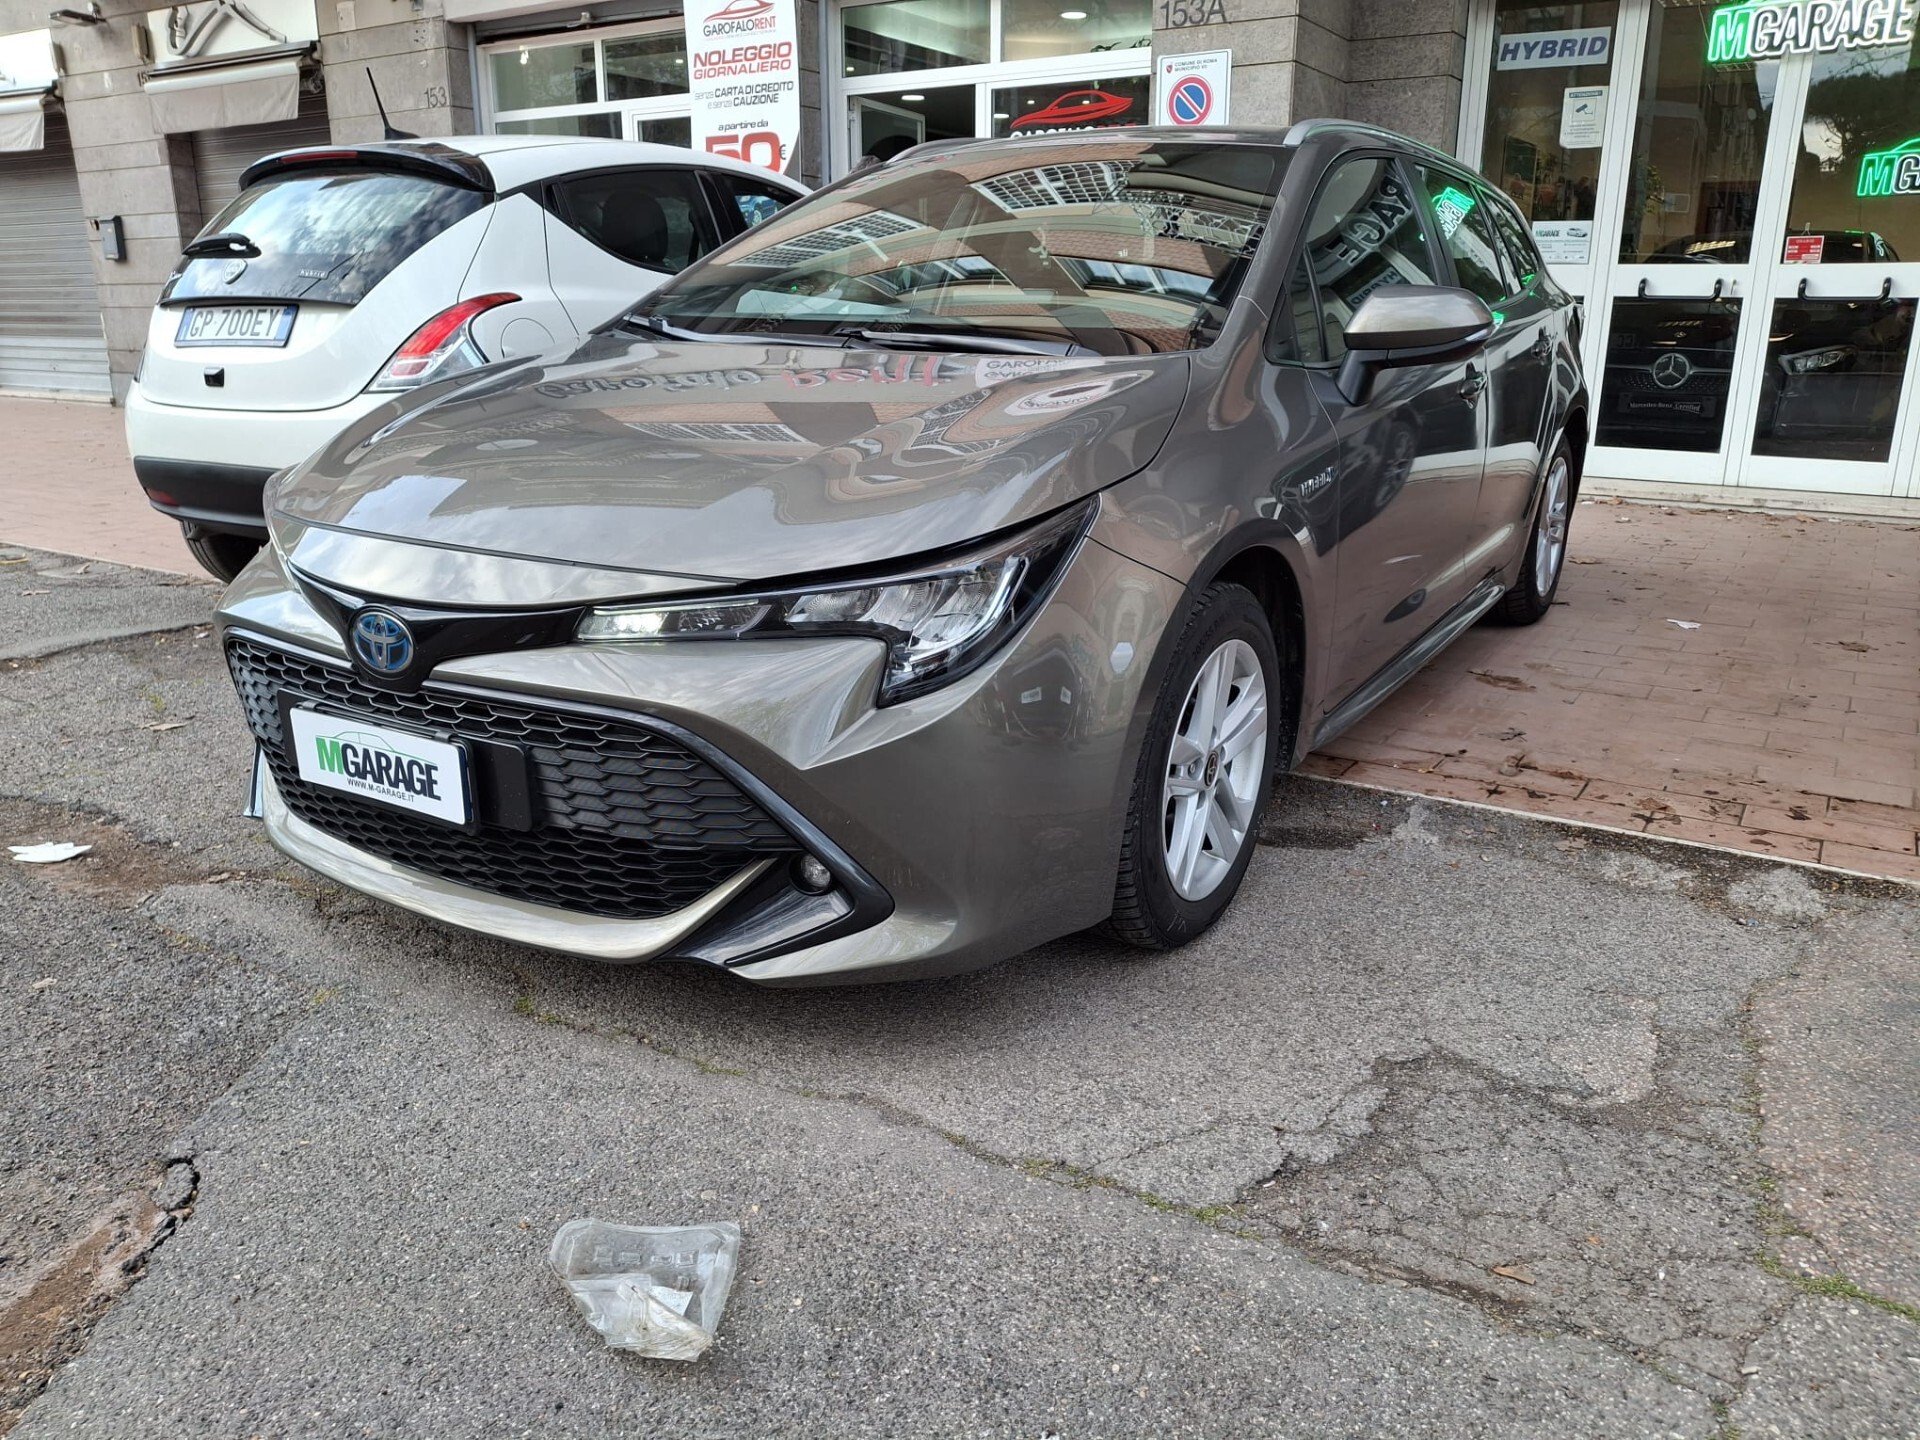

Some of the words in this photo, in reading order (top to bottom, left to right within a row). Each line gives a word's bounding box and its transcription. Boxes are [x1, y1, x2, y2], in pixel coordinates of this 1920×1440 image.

[1160, 0, 1227, 29] 153A
[693, 41, 792, 68] NOLEGGIO
[1500, 36, 1608, 61] HYBRID
[693, 59, 792, 80] GIORNALIERO
[423, 86, 447, 109] 153
[714, 85, 744, 98] CARTA
[745, 84, 754, 94] DI
[755, 81, 794, 94] CREDITO
[733, 93, 779, 107] CAUZIONE
[724, 120, 756, 132] partire
[757, 119, 769, 127] da
[190, 309, 214, 337] GP
[215, 308, 280, 337] 700EY
[315, 737, 442, 802] MGARAGE
[347, 777, 415, 803] WWW.M-GARAGE.IT
